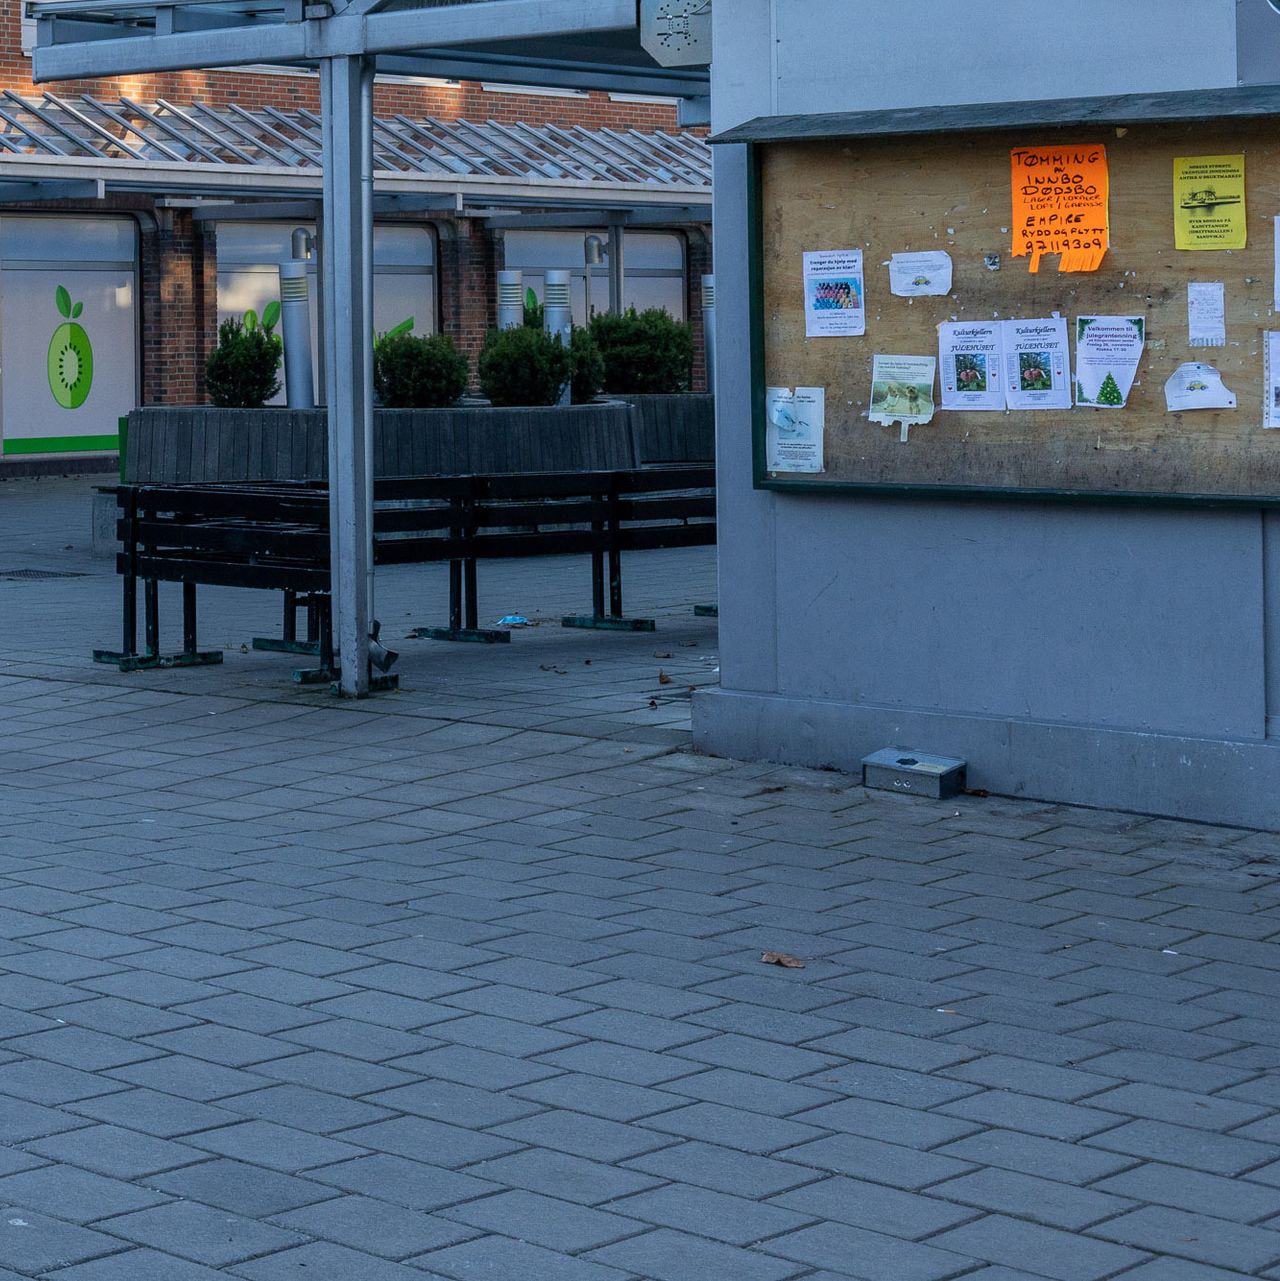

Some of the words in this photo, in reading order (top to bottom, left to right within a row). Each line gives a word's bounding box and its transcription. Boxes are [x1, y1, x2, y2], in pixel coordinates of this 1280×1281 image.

[1012, 151, 1099, 167] TØMMING
[1027, 173, 1084, 185] INNBO
[1020, 184, 1097, 195] DØDSBO
[1026, 214, 1085, 227] EMPIRE
[1021, 229, 1051, 238] RYDD
[1071, 227, 1105, 235] FLYTT
[951, 344, 995, 352] JULEHUSET
[1014, 342, 1060, 350] JULEHUSET
